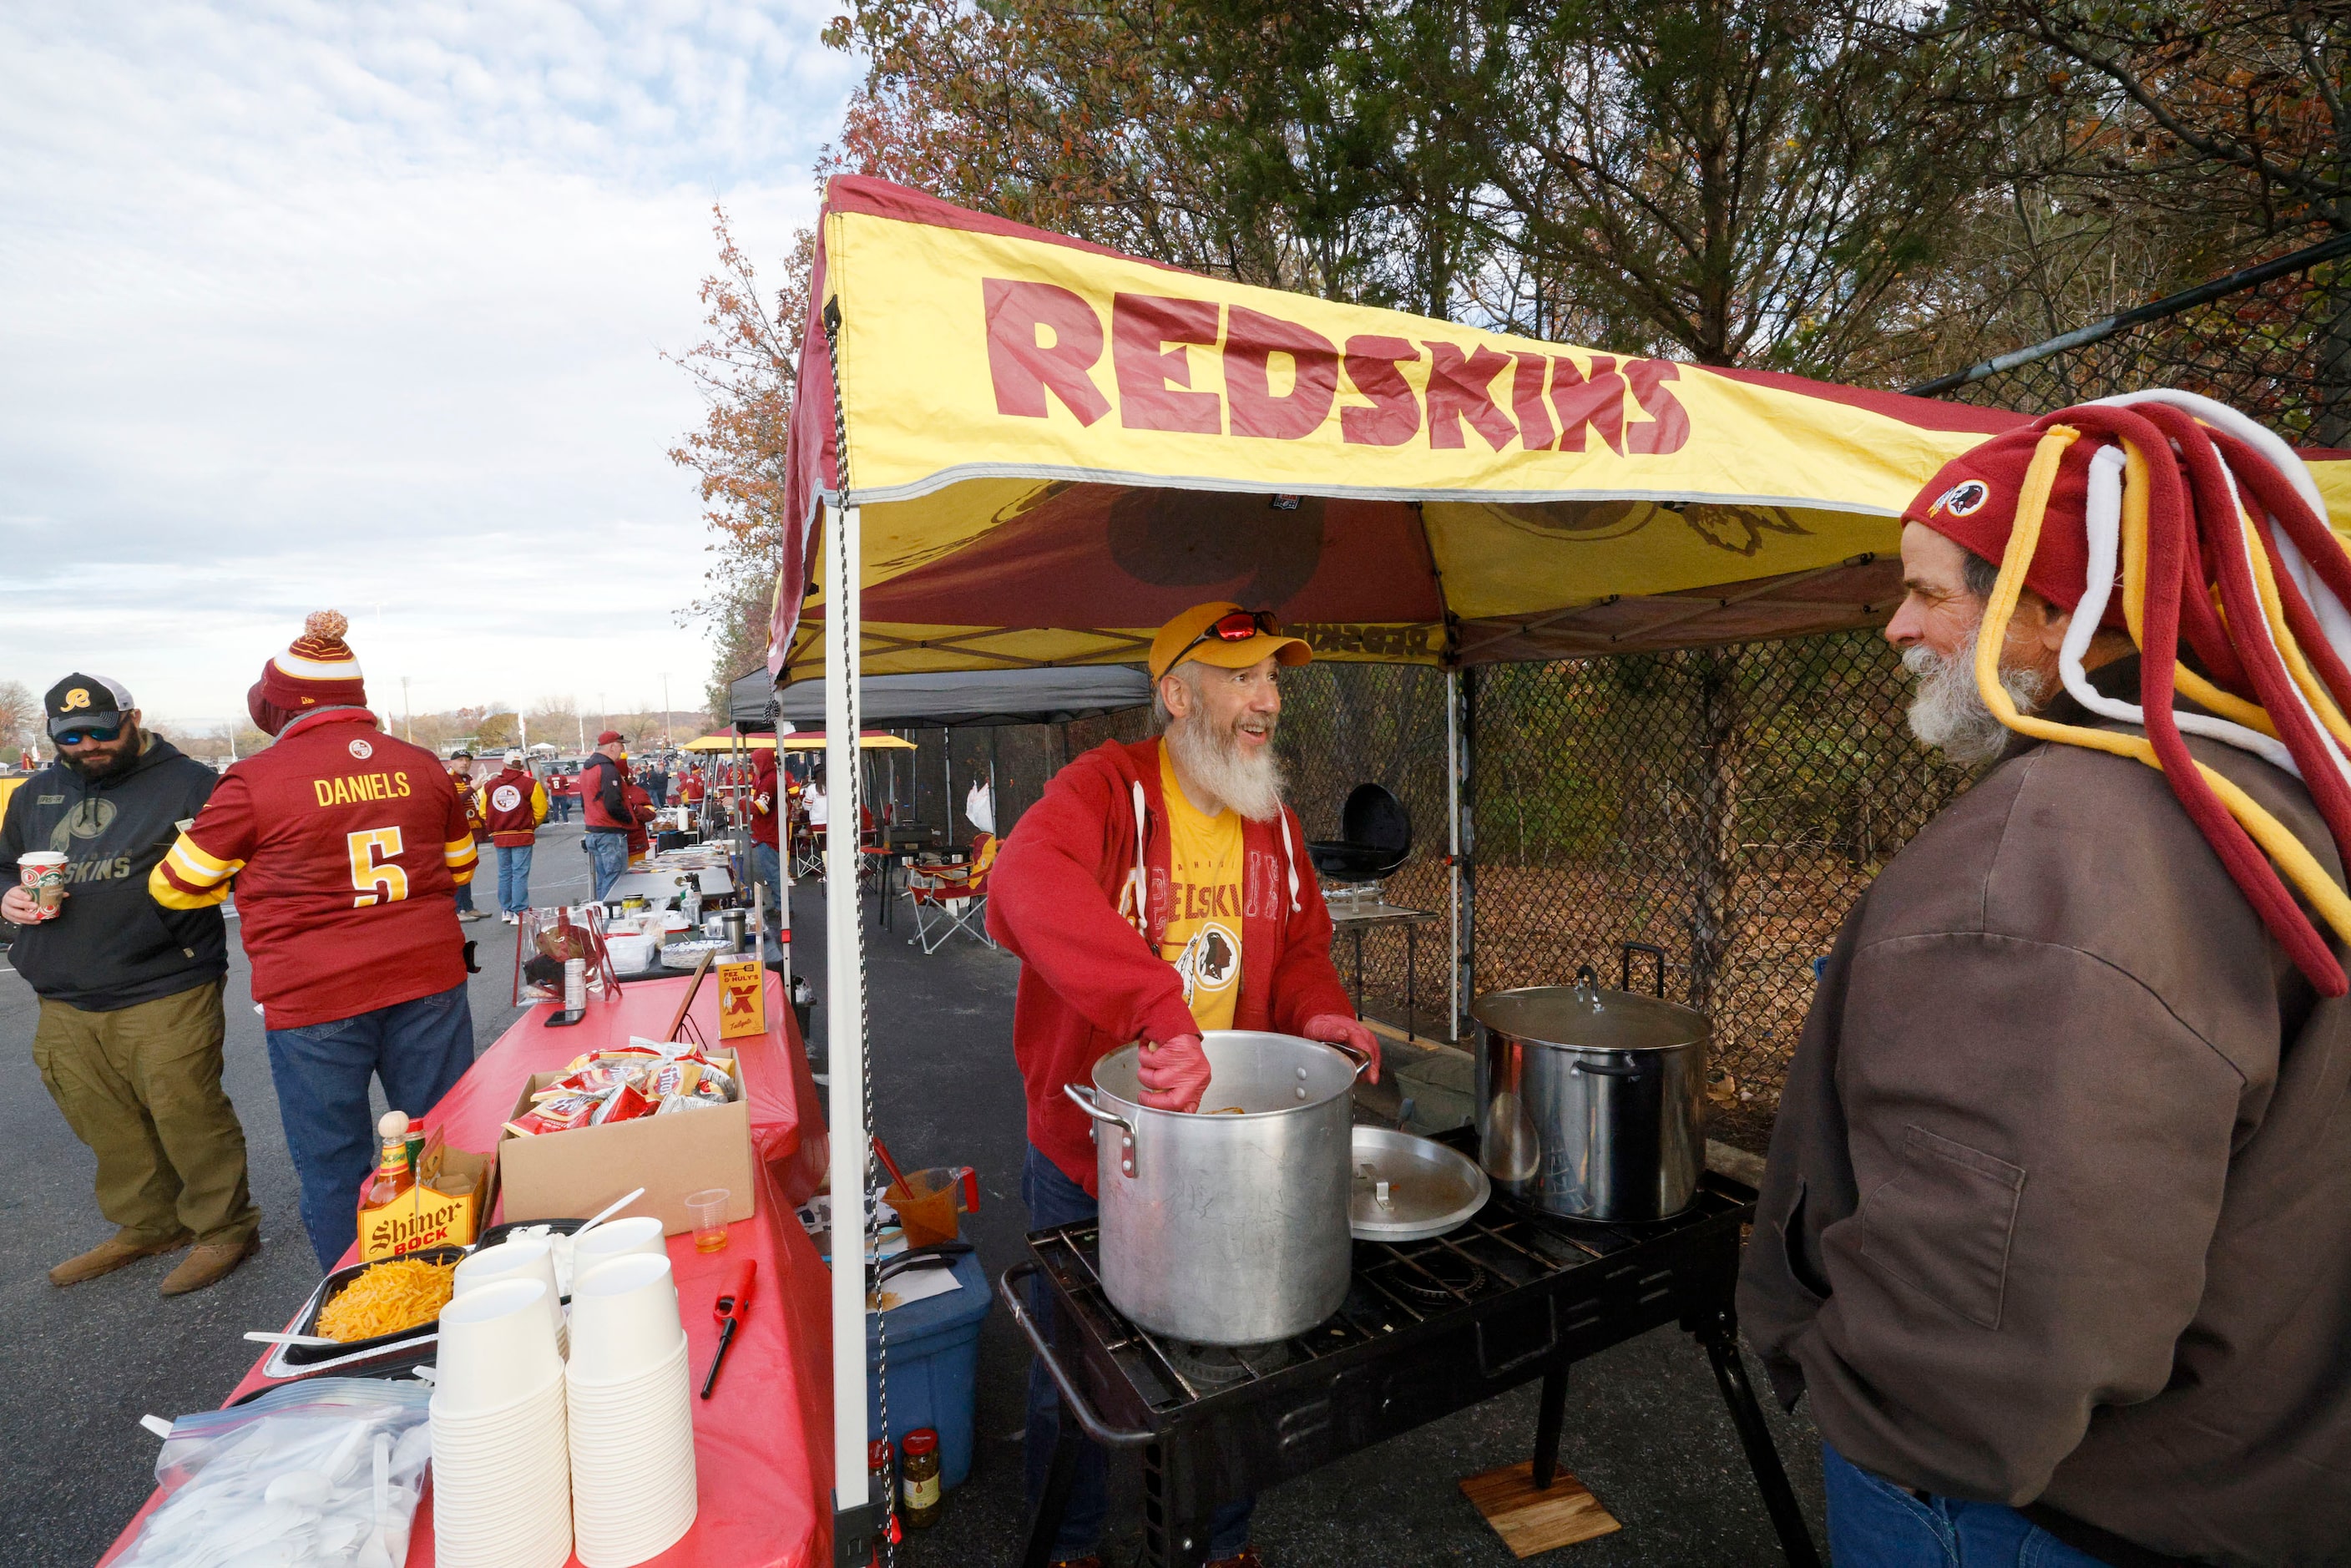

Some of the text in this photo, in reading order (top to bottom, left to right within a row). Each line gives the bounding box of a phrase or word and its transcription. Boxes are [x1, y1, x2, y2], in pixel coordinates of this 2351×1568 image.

[981, 276, 1691, 458] REDSKINS
[313, 771, 412, 808] DANIELS
[553, 780, 560, 790] 8
[346, 825, 409, 908] 5
[369, 1202, 463, 1255] Shiner
[394, 1227, 448, 1256] BOCK
